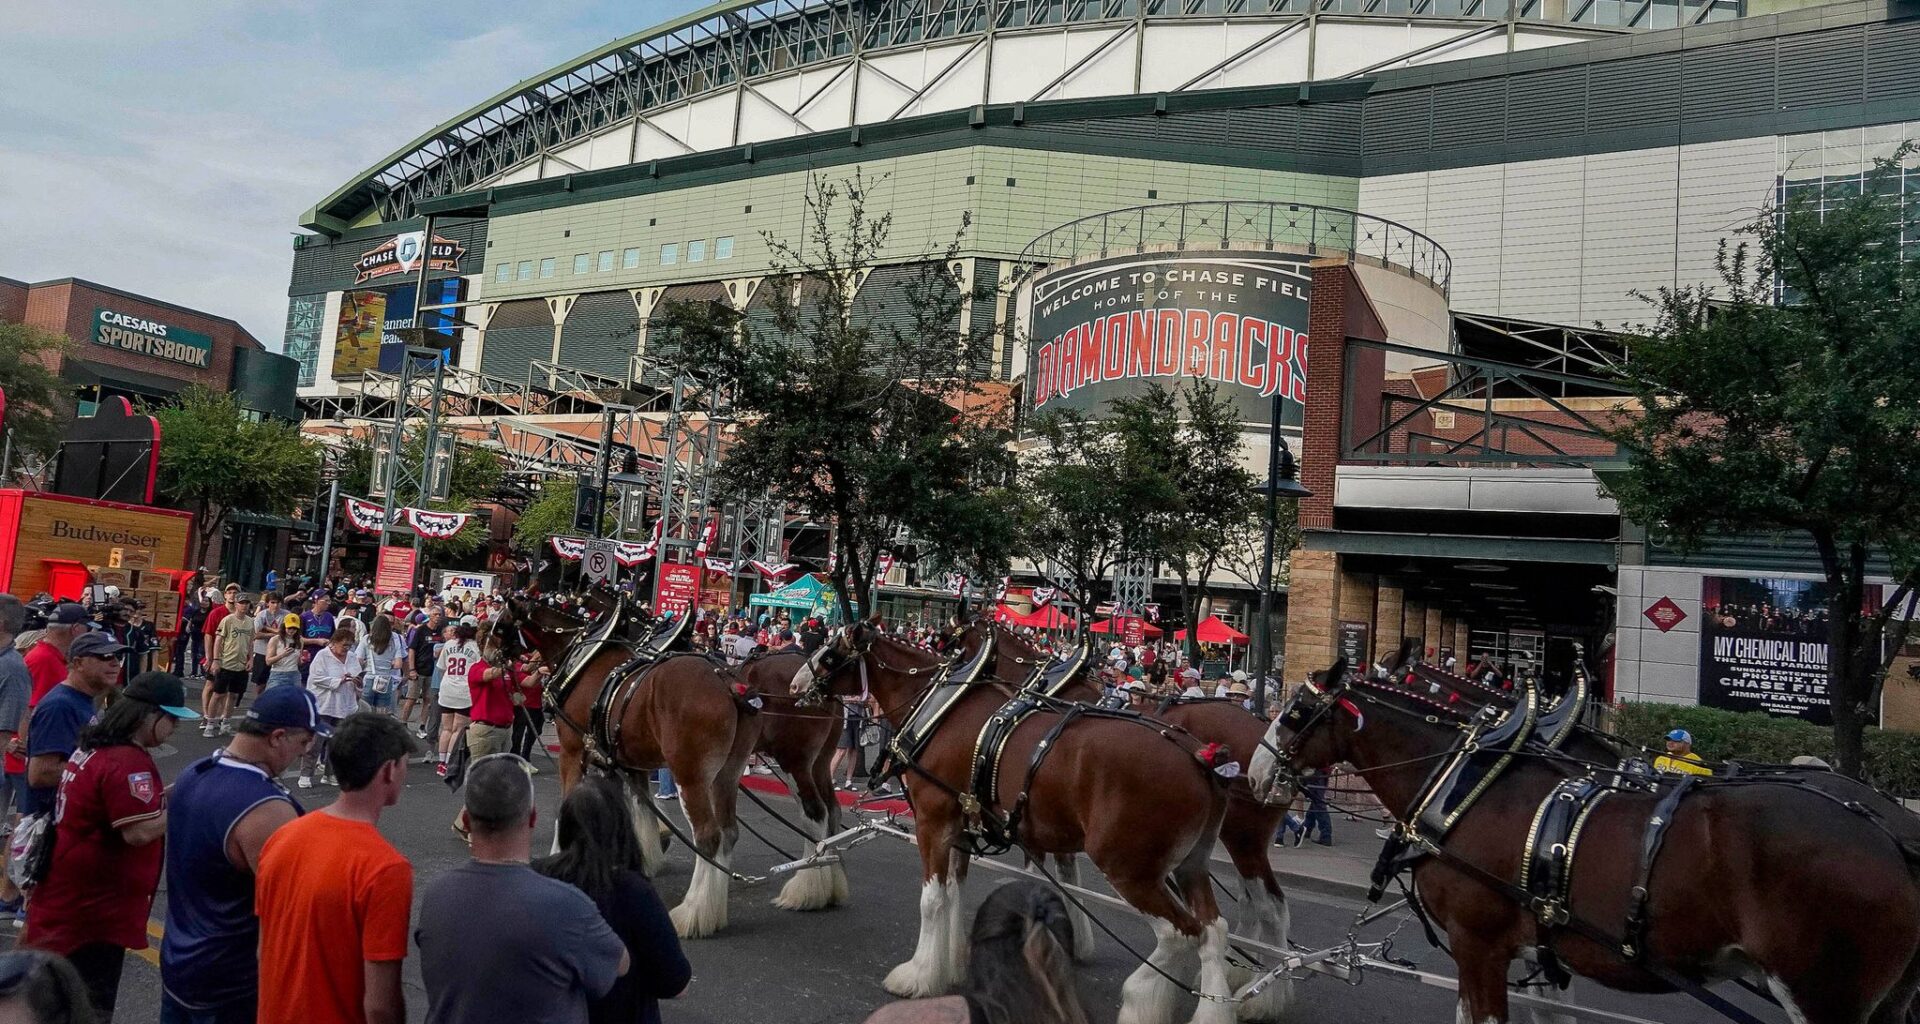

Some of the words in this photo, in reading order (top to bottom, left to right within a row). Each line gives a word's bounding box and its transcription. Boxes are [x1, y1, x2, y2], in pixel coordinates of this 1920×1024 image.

[362, 250, 394, 267] CHASE
[1042, 276, 1121, 319] WELCOME
[1129, 271, 1156, 285] TO
[1165, 269, 1245, 286] CHASE
[1255, 276, 1308, 301] FIEL
[1094, 292, 1144, 310] HOME
[1158, 290, 1183, 301] OF
[1197, 291, 1238, 303] THE
[99, 310, 168, 336] CAESARS
[383, 318, 413, 330] anner
[97, 324, 208, 366] SPORTSBOOK
[1034, 308, 1308, 412] DIAMONDBACKS
[52, 519, 162, 548] Budweiser
[590, 540, 612, 550] BEGINS
[450, 576, 483, 589] AMR
[724, 644, 735, 656] 13
[1713, 635, 1734, 658] MY
[1735, 637, 1797, 663] CHEMICAL
[1798, 642, 1828, 665] ROM
[447, 656, 467, 676] 28
[1713, 656, 1737, 664] THE
[1739, 658, 1778, 667] BLACK
[1780, 661, 1828, 671] PARADE
[1730, 666, 1767, 674] SUNDAY
[1769, 669, 1828, 679] SEPTEMBER
[1719, 677, 1785, 691] CHASE
[1792, 683, 1826, 695] FIE
[1811, 678, 1828, 686] AZ
[1728, 690, 1769, 700] JIMMY
[1770, 694, 1794, 702] EAT
[1796, 696, 1831, 706] WORL
